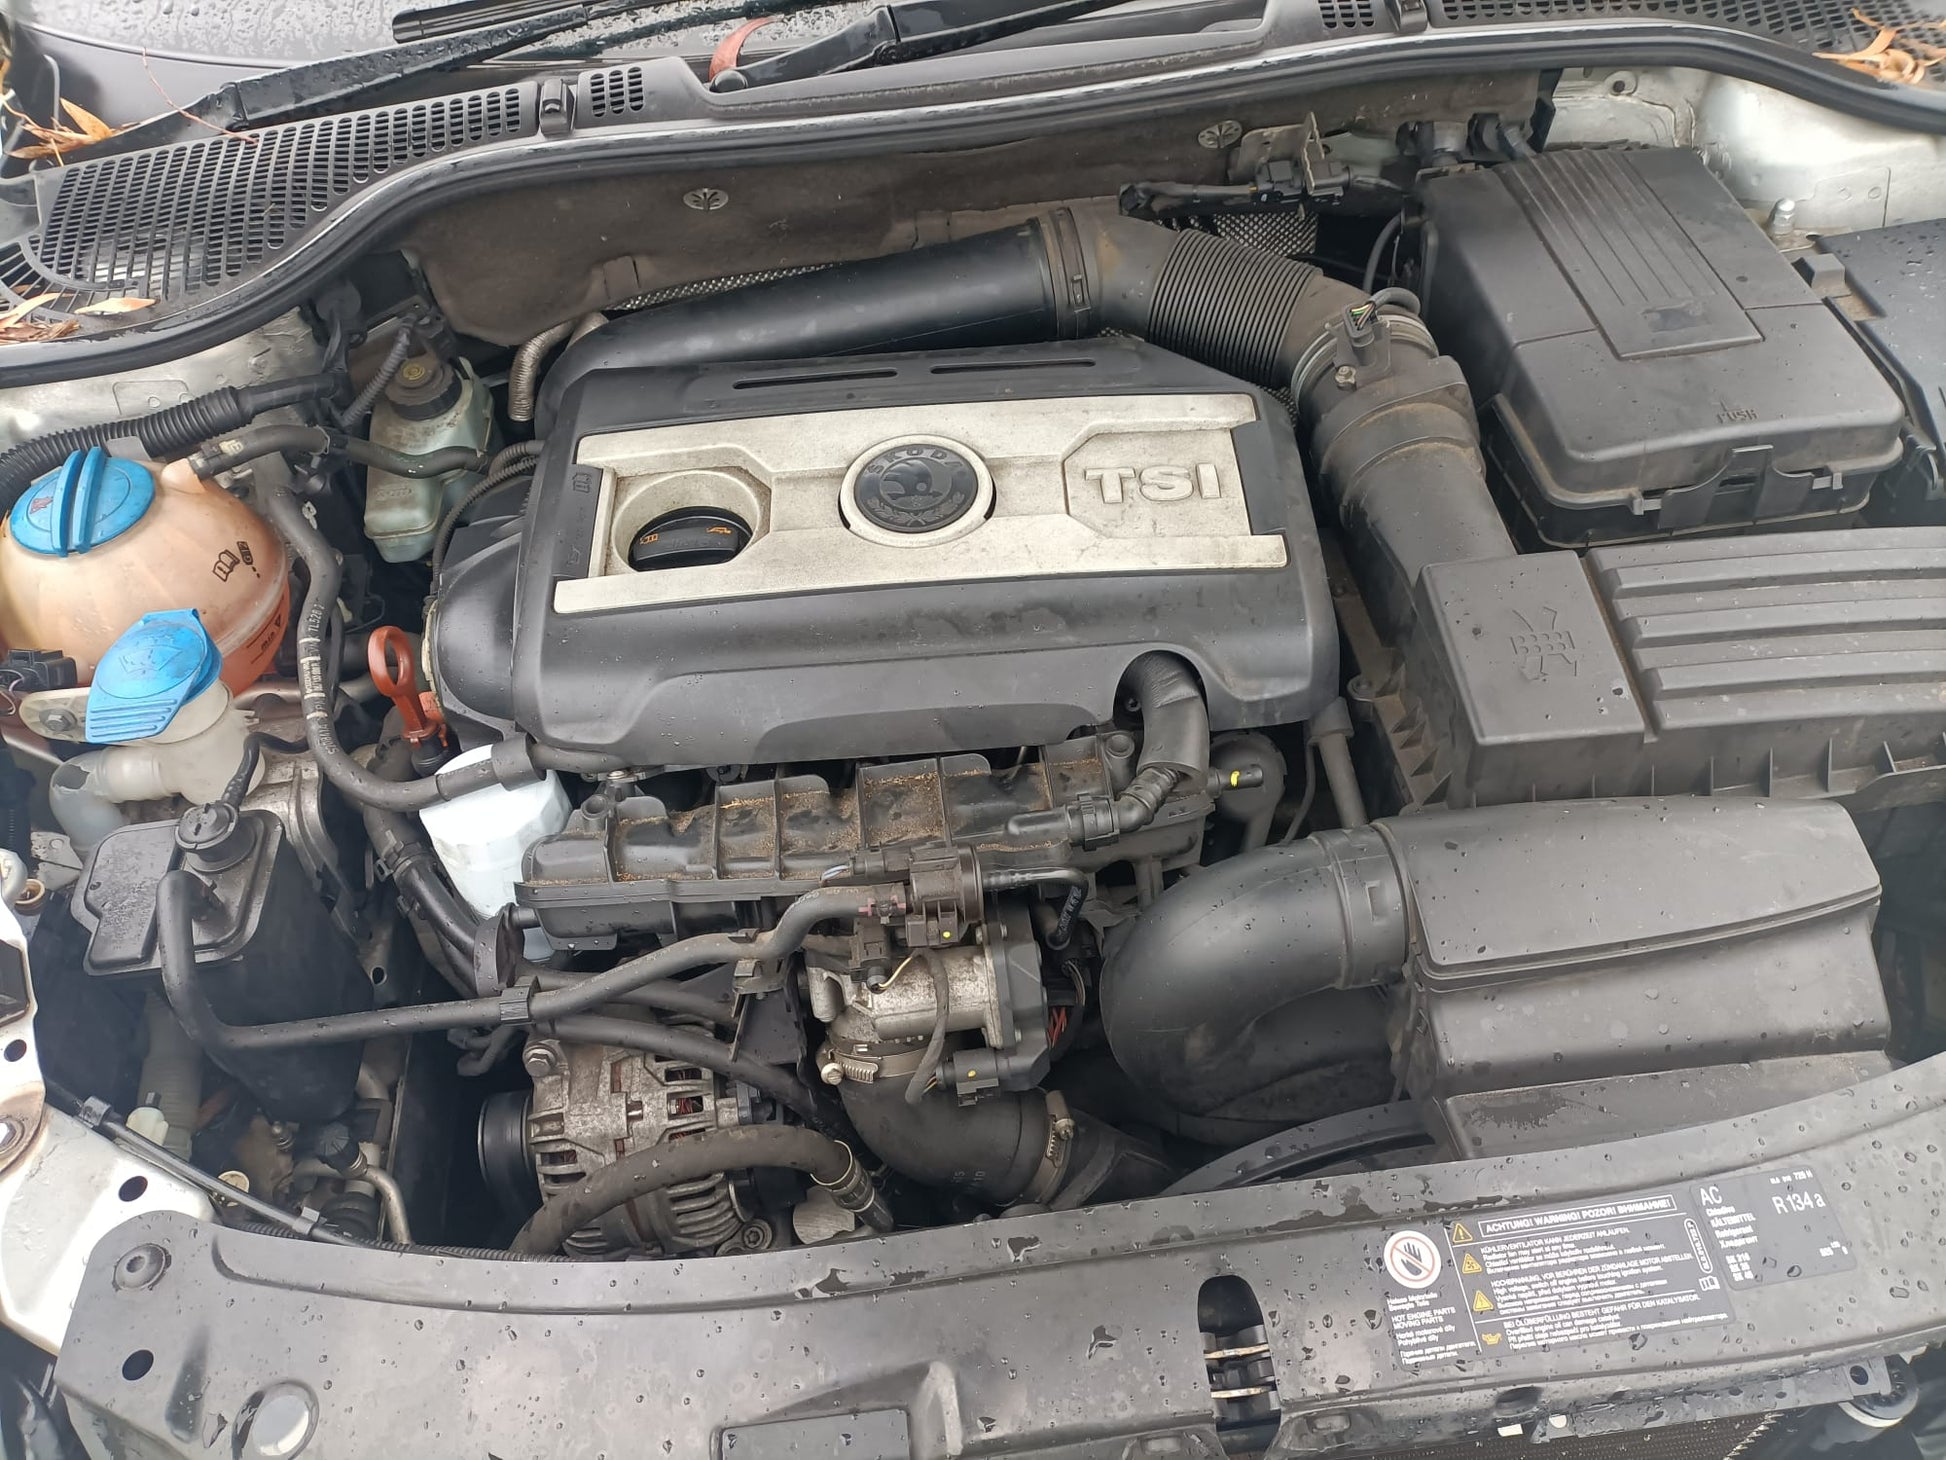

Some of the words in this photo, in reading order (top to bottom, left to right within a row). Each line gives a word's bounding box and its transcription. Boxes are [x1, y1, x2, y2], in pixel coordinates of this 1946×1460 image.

[1084, 463, 1222, 503] TSI
[1700, 1186, 1722, 1206] AC
[1771, 1195, 1788, 1215] R
[1786, 1191, 1814, 1212] 134
[1813, 1193, 1826, 1208] a
[1487, 1218, 1534, 1233] ACHTUNG!
[1534, 1212, 1581, 1225] WARNING!
[1581, 1207, 1616, 1219] POZOR!
[1392, 1314, 1405, 1322] HOT
[1407, 1310, 1433, 1320] ENGINE
[1433, 1307, 1456, 1315] PARTS
[1628, 1302, 1641, 1310] FÜR
[1393, 1319, 1420, 1329] MOVING
[1421, 1316, 1443, 1325] PARTS
